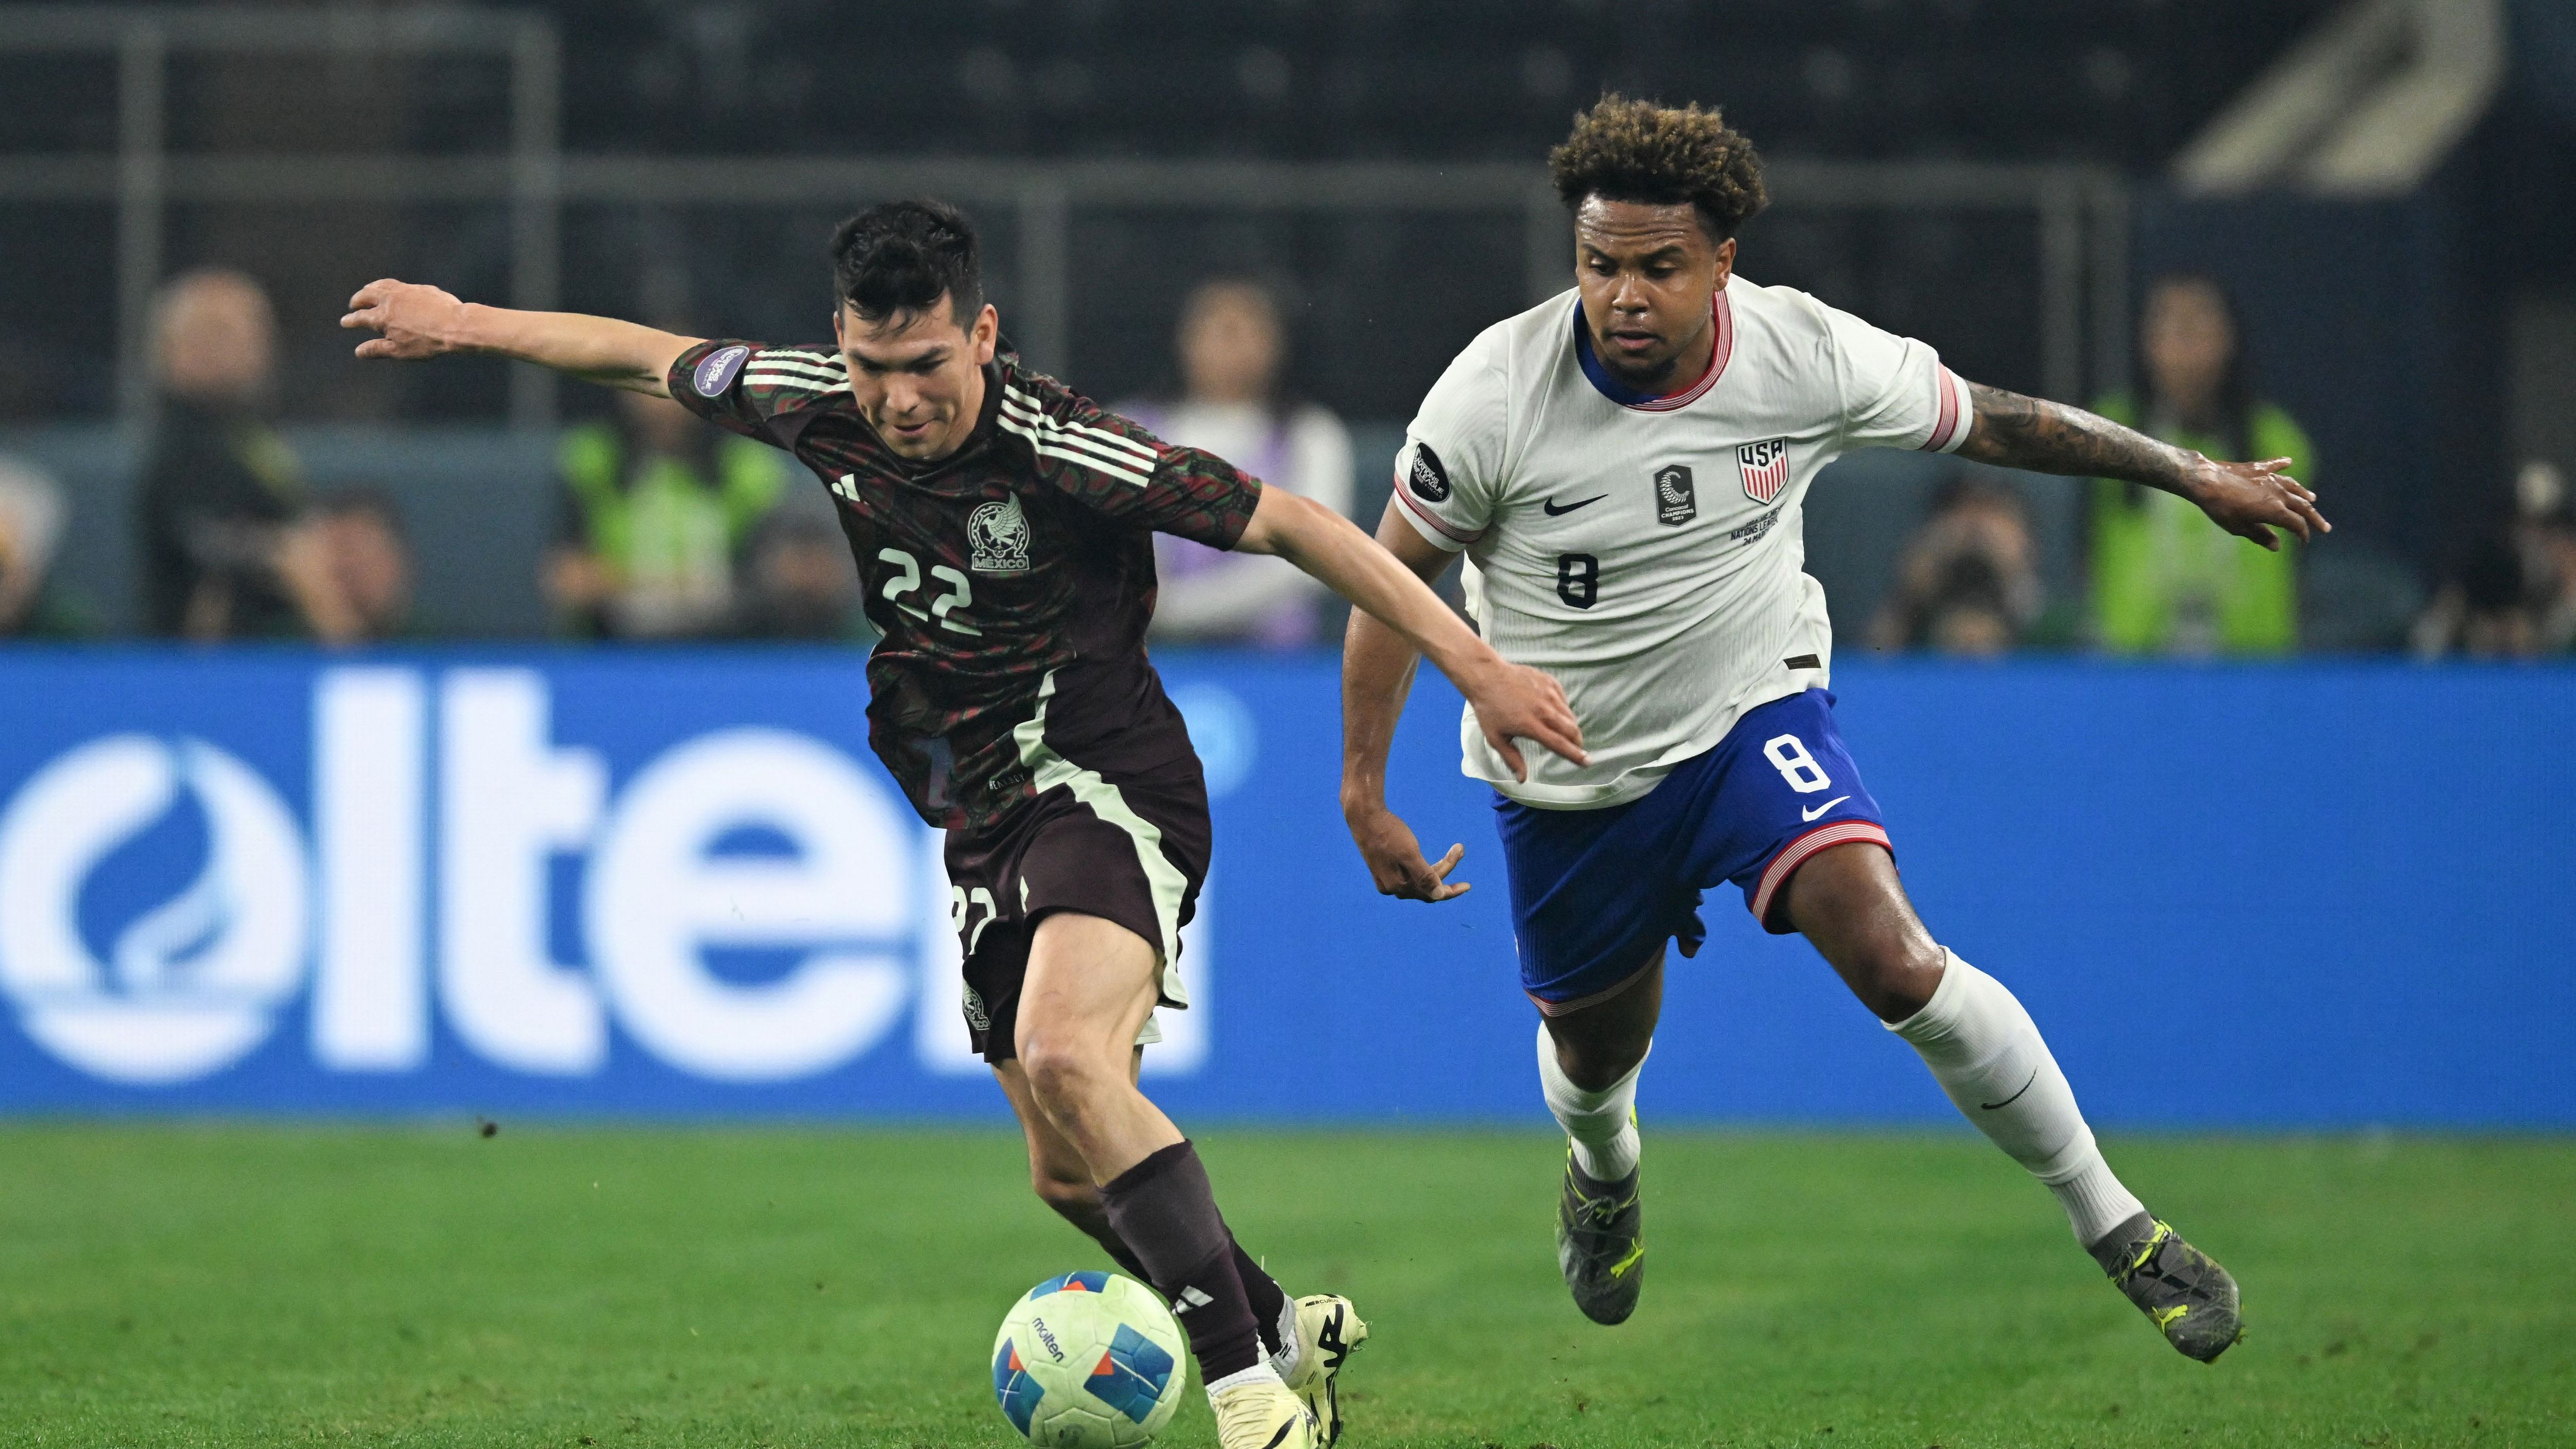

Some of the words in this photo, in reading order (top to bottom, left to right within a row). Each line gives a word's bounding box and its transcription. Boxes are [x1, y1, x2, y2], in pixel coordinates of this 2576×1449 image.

[1740, 439, 1783, 467] USA
[1416, 458, 1439, 484] NATIONS
[1419, 470, 1444, 494] LEAGUE
[1661, 508, 1695, 518] CHAMPIONS
[1665, 504, 1689, 512] Concacaf
[1731, 525, 1758, 540] NATIONS
[974, 556, 1026, 569] MÉXICO
[878, 547, 982, 636] 22
[1556, 552, 1599, 610] 8
[1763, 733, 1832, 794] 8
[1032, 1317, 1065, 1363] molten
